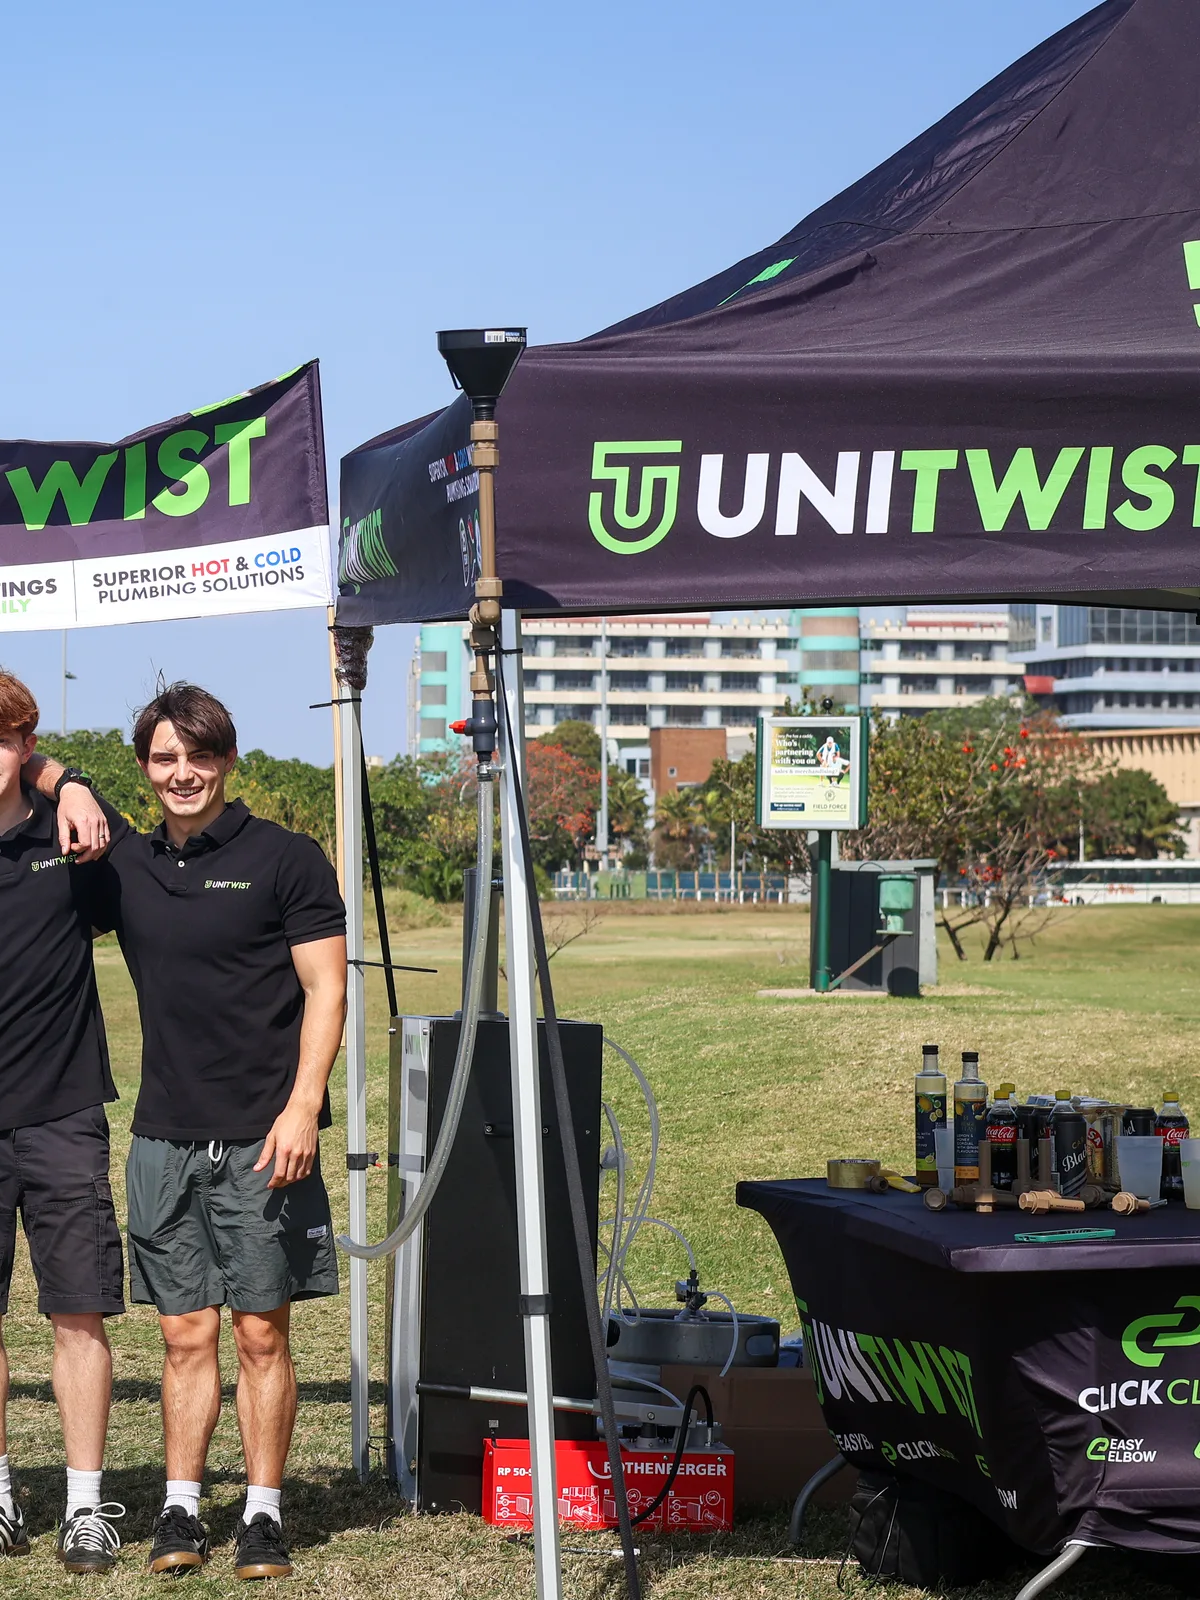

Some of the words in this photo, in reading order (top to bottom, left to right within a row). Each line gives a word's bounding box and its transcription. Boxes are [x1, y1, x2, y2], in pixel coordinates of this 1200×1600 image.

[93, 564, 187, 588] SUPERIOR
[191, 558, 230, 577] HOT
[235, 556, 250, 572] &
[254, 547, 302, 568] COLD
[98, 580, 197, 604] PLUMBING
[202, 565, 305, 593] SOLUTIONS
[775, 749, 814, 757] partnering
[212, 881, 251, 889] UNITWIST
[812, 1318, 983, 1439] UNITWIST
[1078, 1379, 1164, 1414] CLICK
[897, 1440, 938, 1460] CLICK
[1110, 1438, 1144, 1451] EASY
[1108, 1451, 1157, 1463] ELBOW
[497, 1467, 511, 1476] RP
